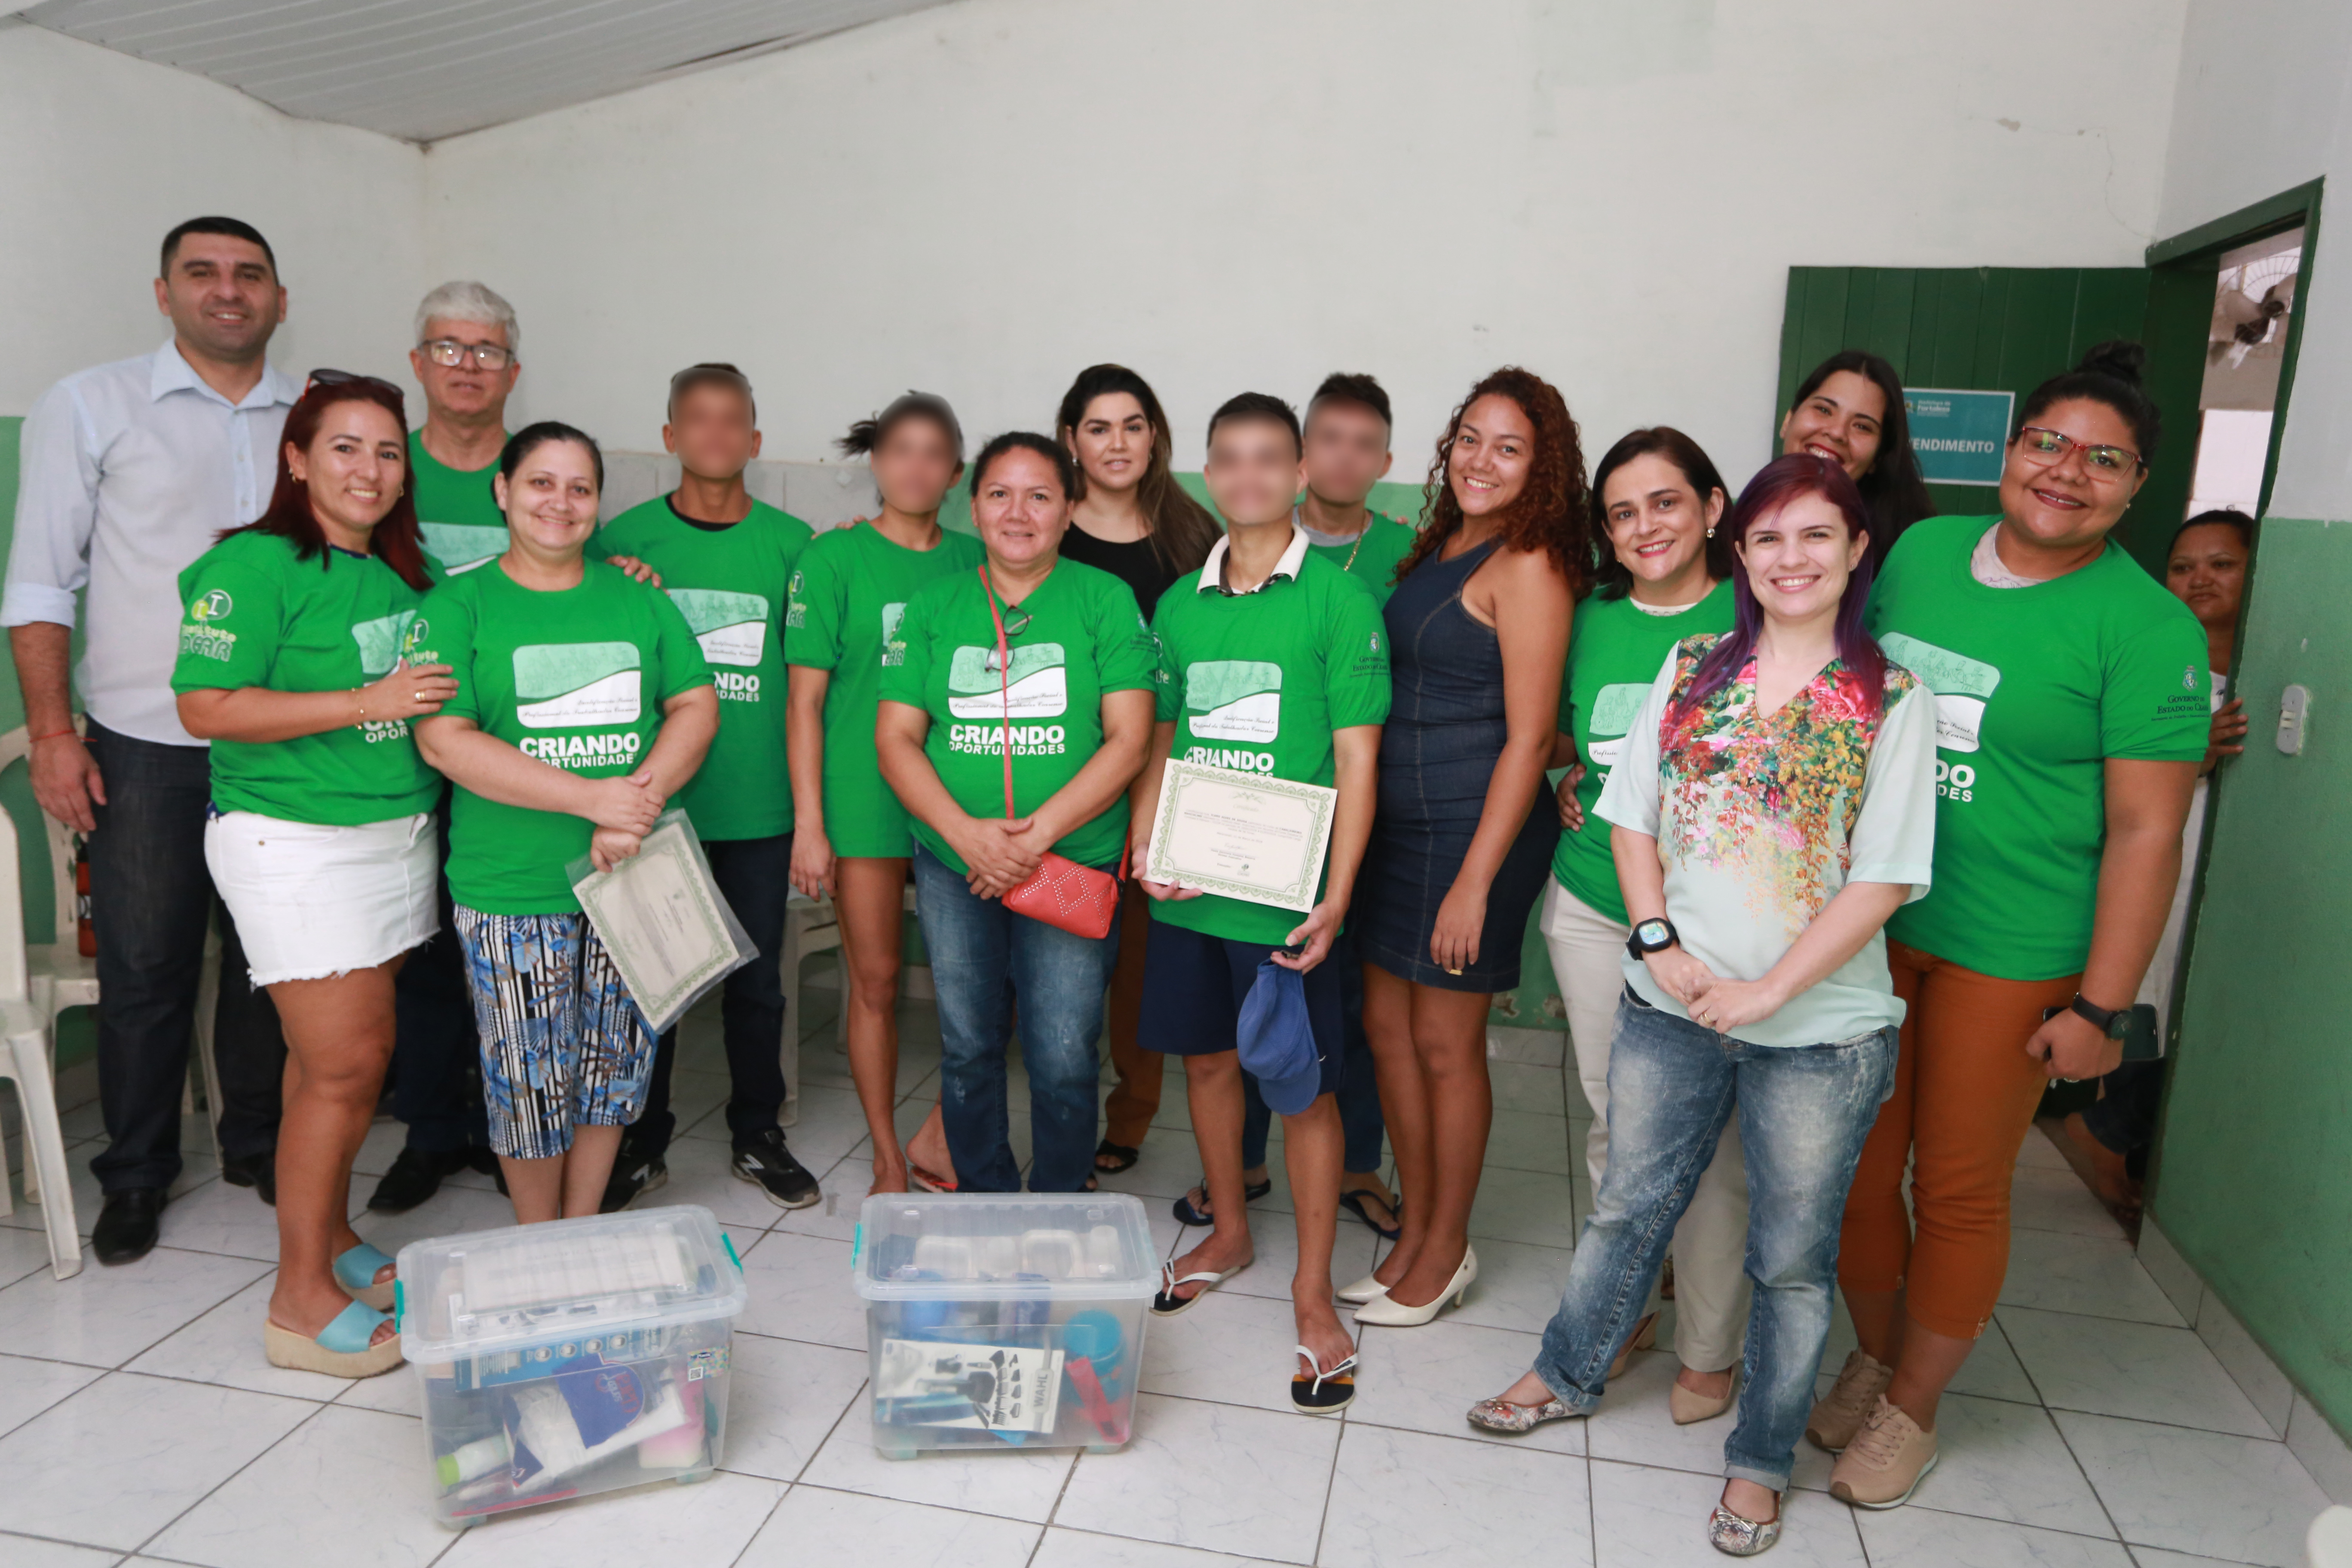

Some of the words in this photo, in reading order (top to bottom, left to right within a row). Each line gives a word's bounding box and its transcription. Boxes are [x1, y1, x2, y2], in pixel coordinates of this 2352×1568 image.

[1910, 438, 1995, 453] ENDIMENTO
[2167, 694, 2199, 703] GOVERNO
[2157, 705, 2186, 714] ESTADO
[949, 724, 1066, 745] CRIANDO
[519, 732, 640, 758] CRIANDO
[1592, 749, 1618, 757] Profissio
[1184, 746, 1274, 772] CRIANDO
[1034, 1373, 1048, 1407] WAHL
